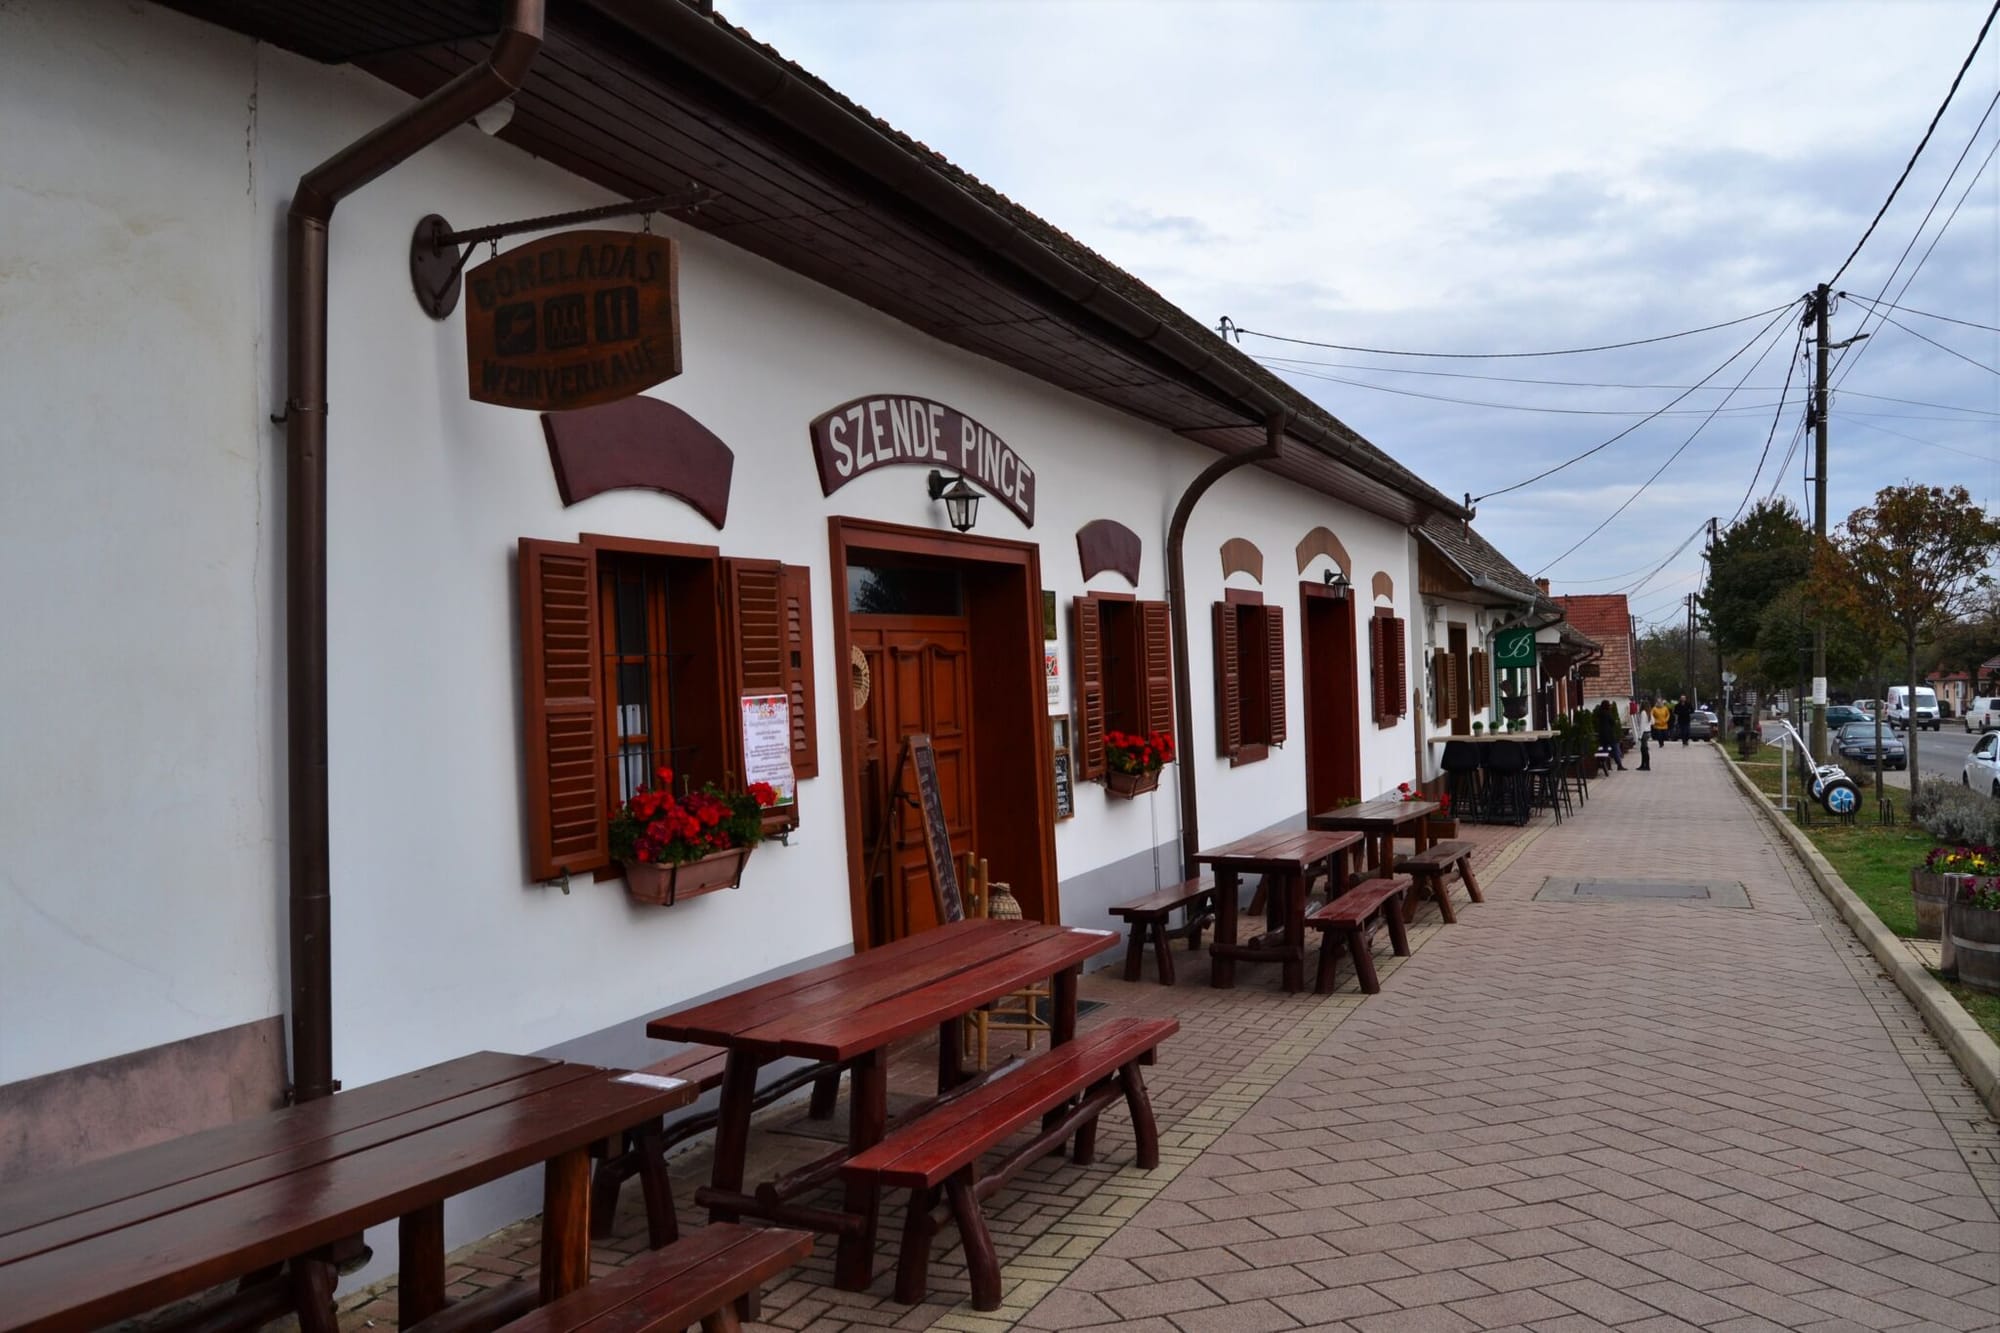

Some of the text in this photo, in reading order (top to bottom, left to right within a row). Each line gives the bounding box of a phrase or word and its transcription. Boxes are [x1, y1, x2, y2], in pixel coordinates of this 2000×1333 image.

[481, 336, 656, 397] WEINVERKAUF
[829, 399, 1031, 513] SZENDE PINCE
